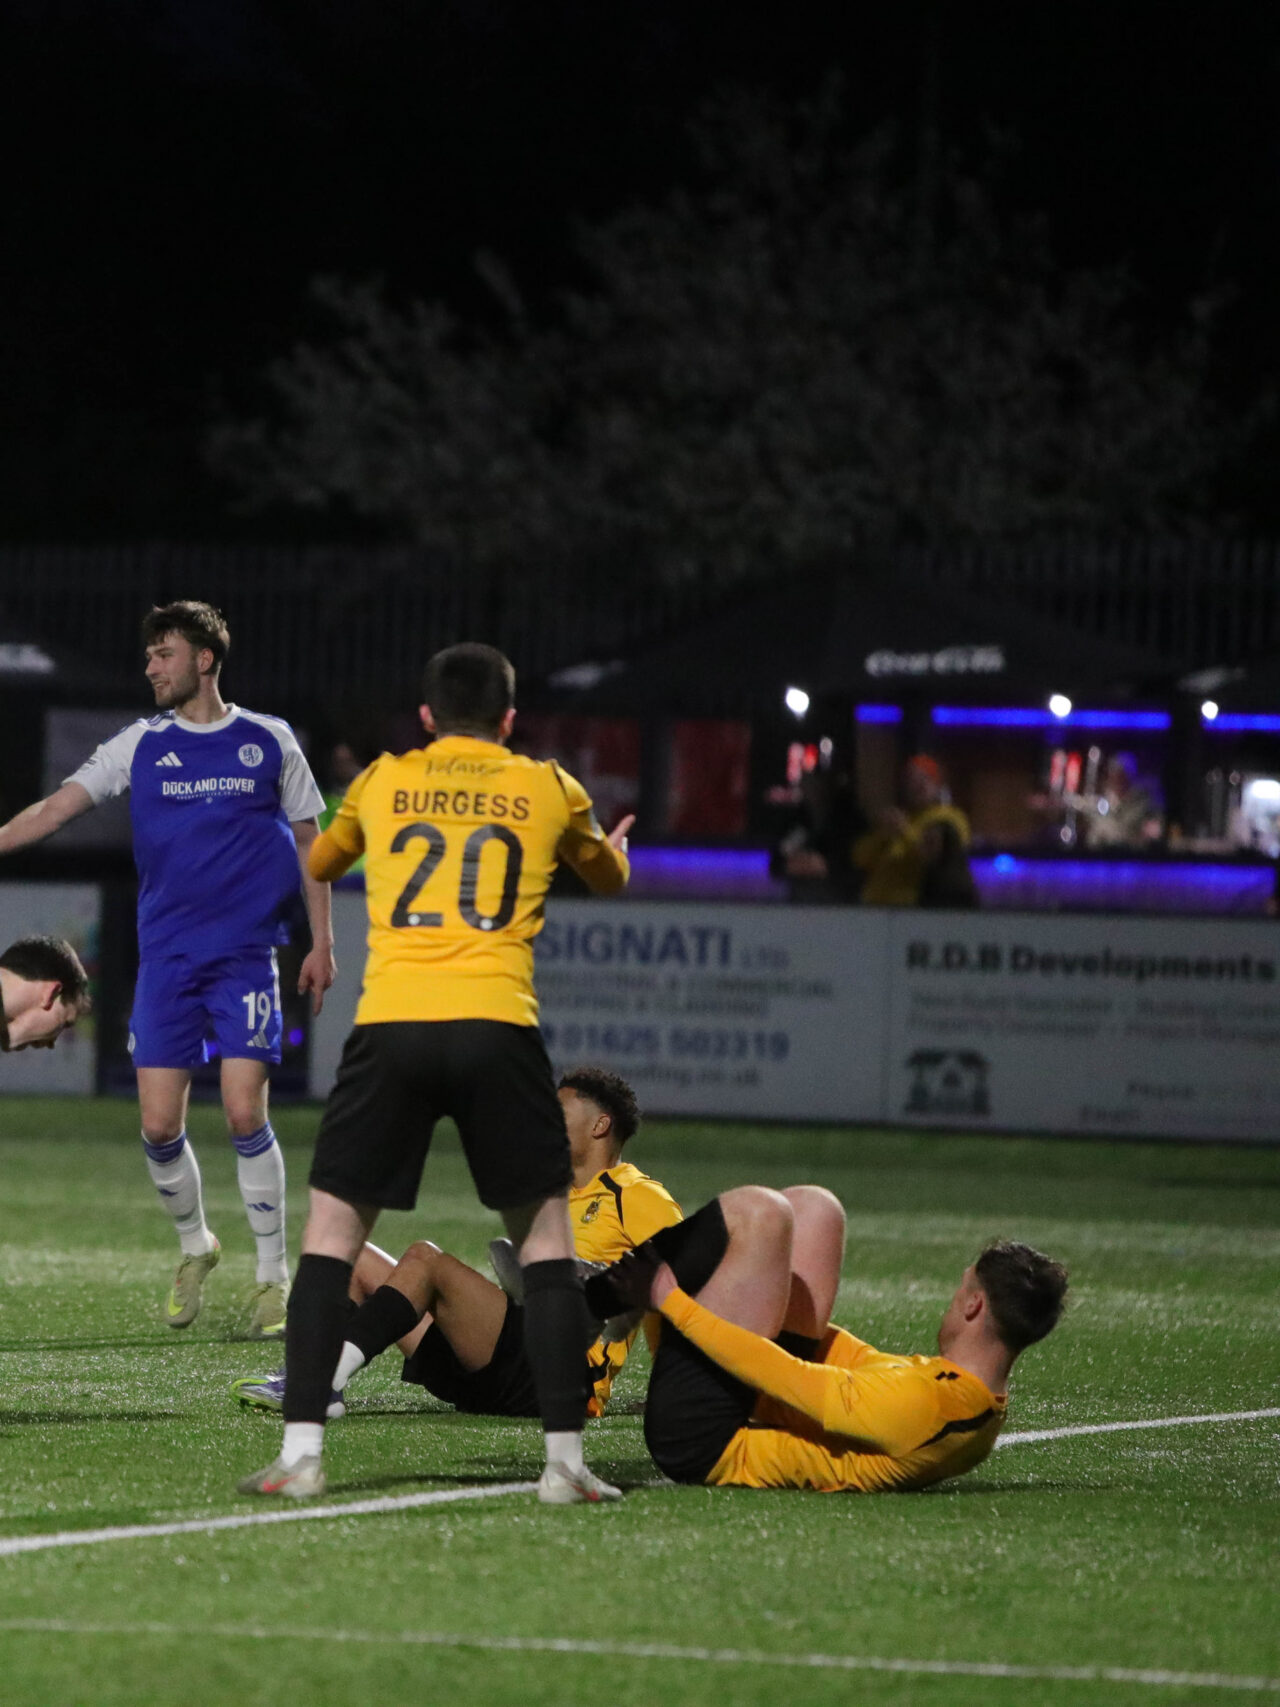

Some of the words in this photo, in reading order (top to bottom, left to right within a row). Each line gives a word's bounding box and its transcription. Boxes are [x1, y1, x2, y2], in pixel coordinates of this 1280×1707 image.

[162, 781, 193, 796] DUCK
[193, 778, 217, 793] AND
[219, 777, 255, 793] COVER
[393, 790, 530, 821] BURGESS
[390, 821, 524, 931] 20
[534, 921, 732, 967] SIGNATI
[1010, 944, 1277, 984] Developments
[242, 991, 271, 1031] 19
